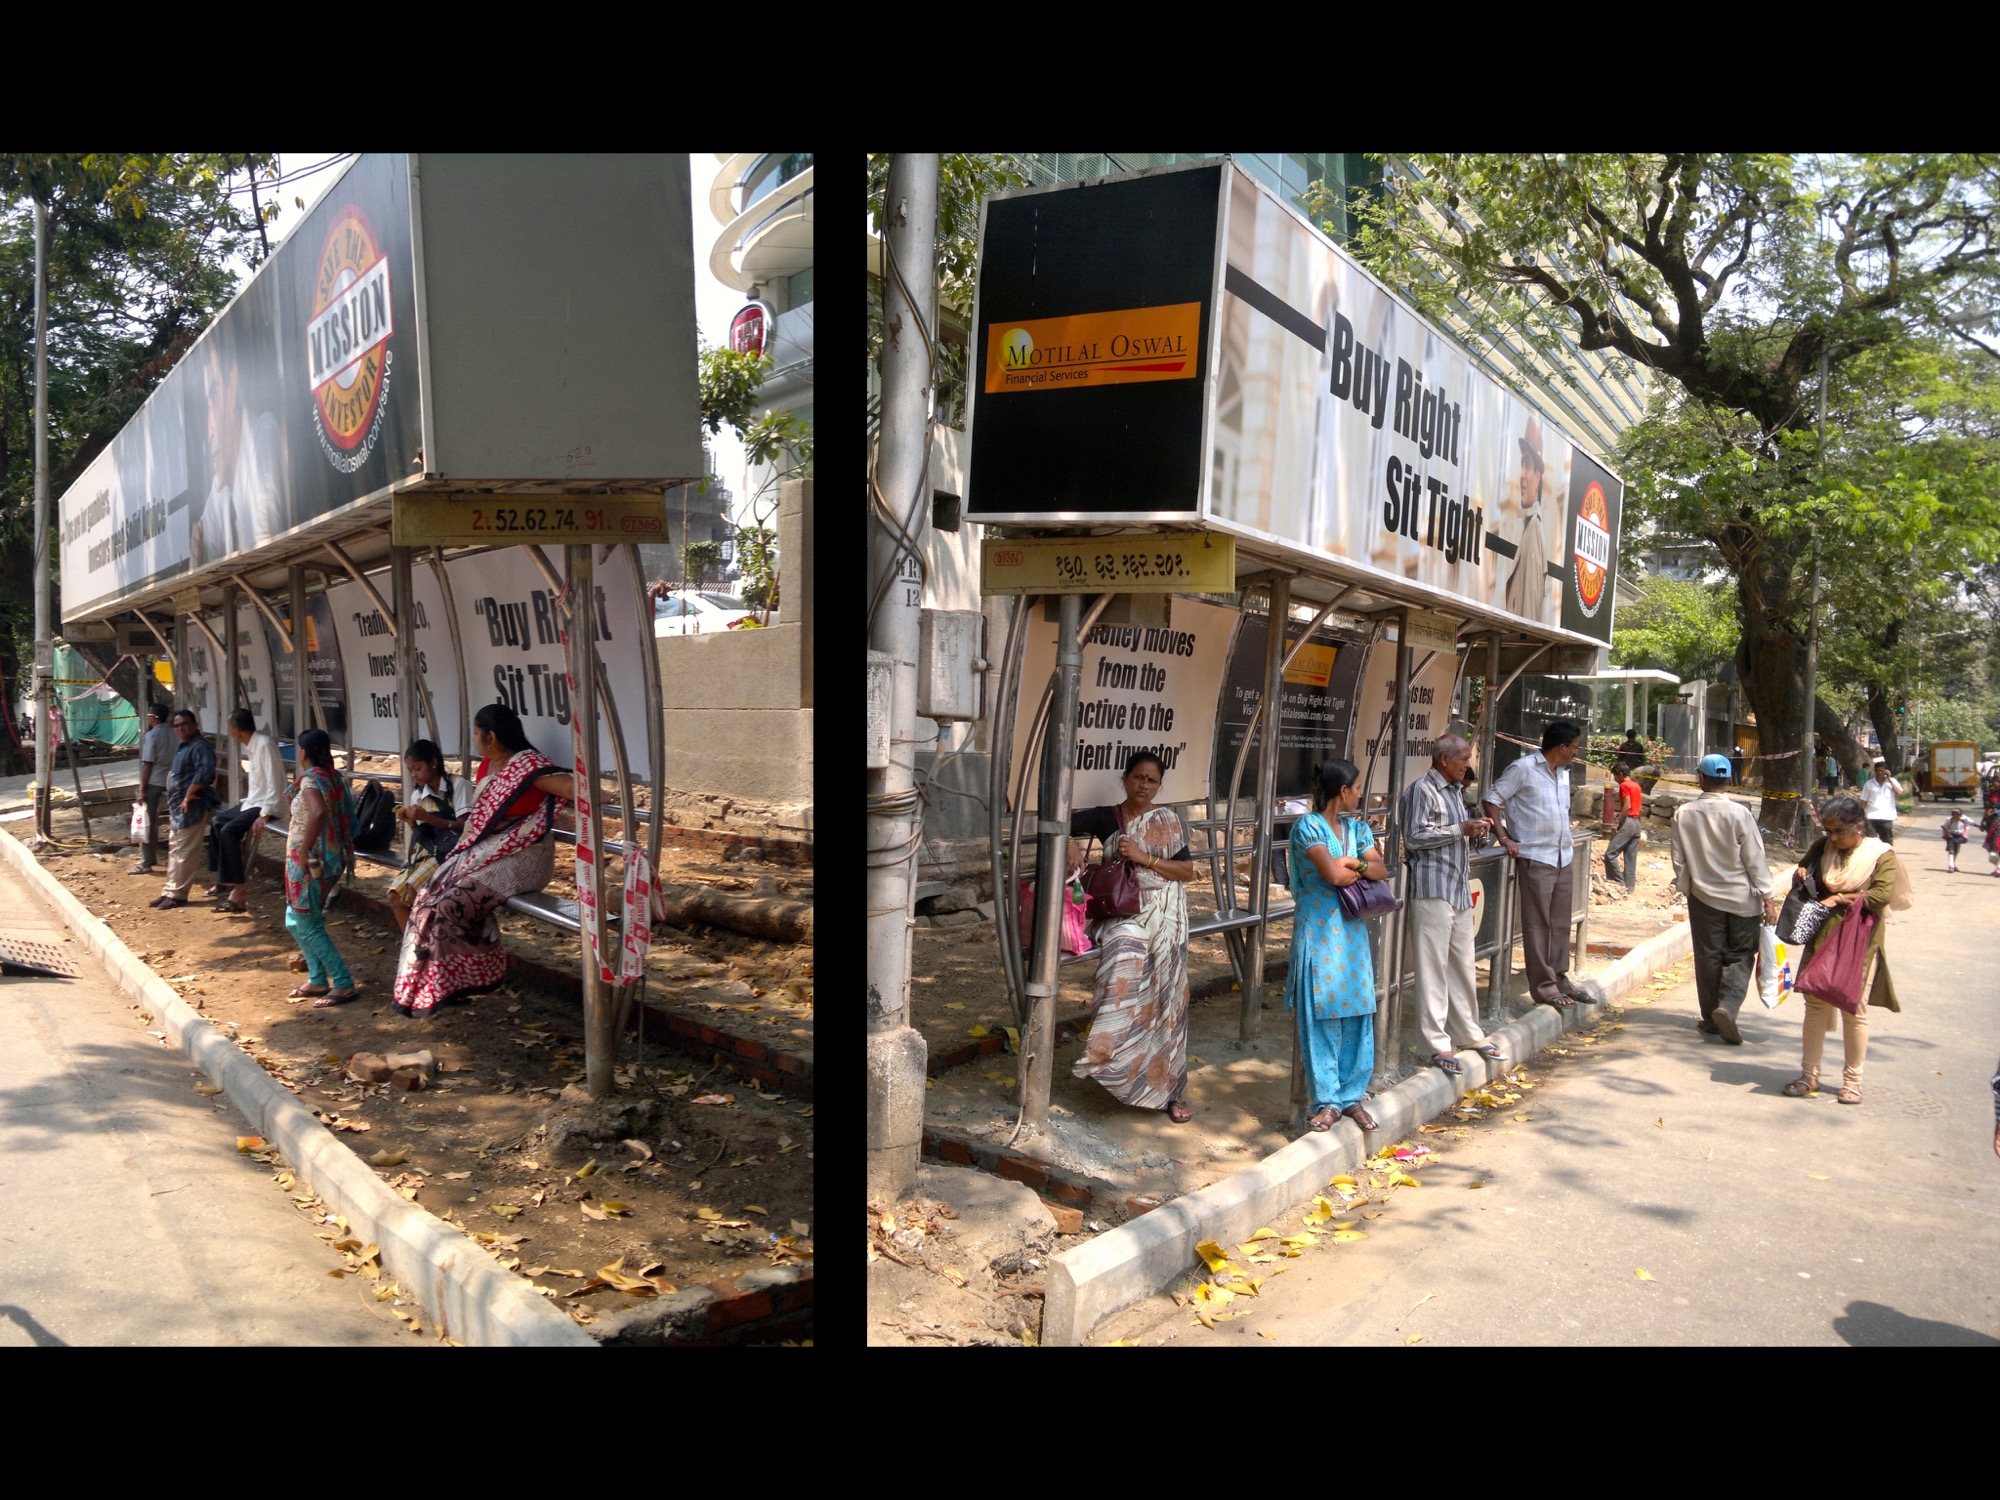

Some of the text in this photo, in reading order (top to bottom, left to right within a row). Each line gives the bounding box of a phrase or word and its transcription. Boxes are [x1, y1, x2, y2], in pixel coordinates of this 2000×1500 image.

[319, 228, 367, 302] SAVE THE
[310, 272, 387, 379] MISSION
[1006, 334, 1188, 367] MOTILAL OSWAL
[322, 356, 379, 434] INVESTOR
[1006, 368, 1089, 385] Financial Services
[1330, 311, 1462, 468] Buy Right
[312, 350, 393, 474] www.motilaloswal.com/save
[1384, 455, 1484, 565] Sit Tight
[1577, 522, 1608, 564] MISSION
[531, 586, 613, 645] Rit
[1143, 627, 1196, 658] moves
[1096, 656, 1167, 693] from the
[371, 693, 393, 718] Test
[1418, 686, 1435, 705] test
[1129, 703, 1146, 730] to
[1148, 702, 1174, 732] the
[1415, 711, 1431, 731] and
